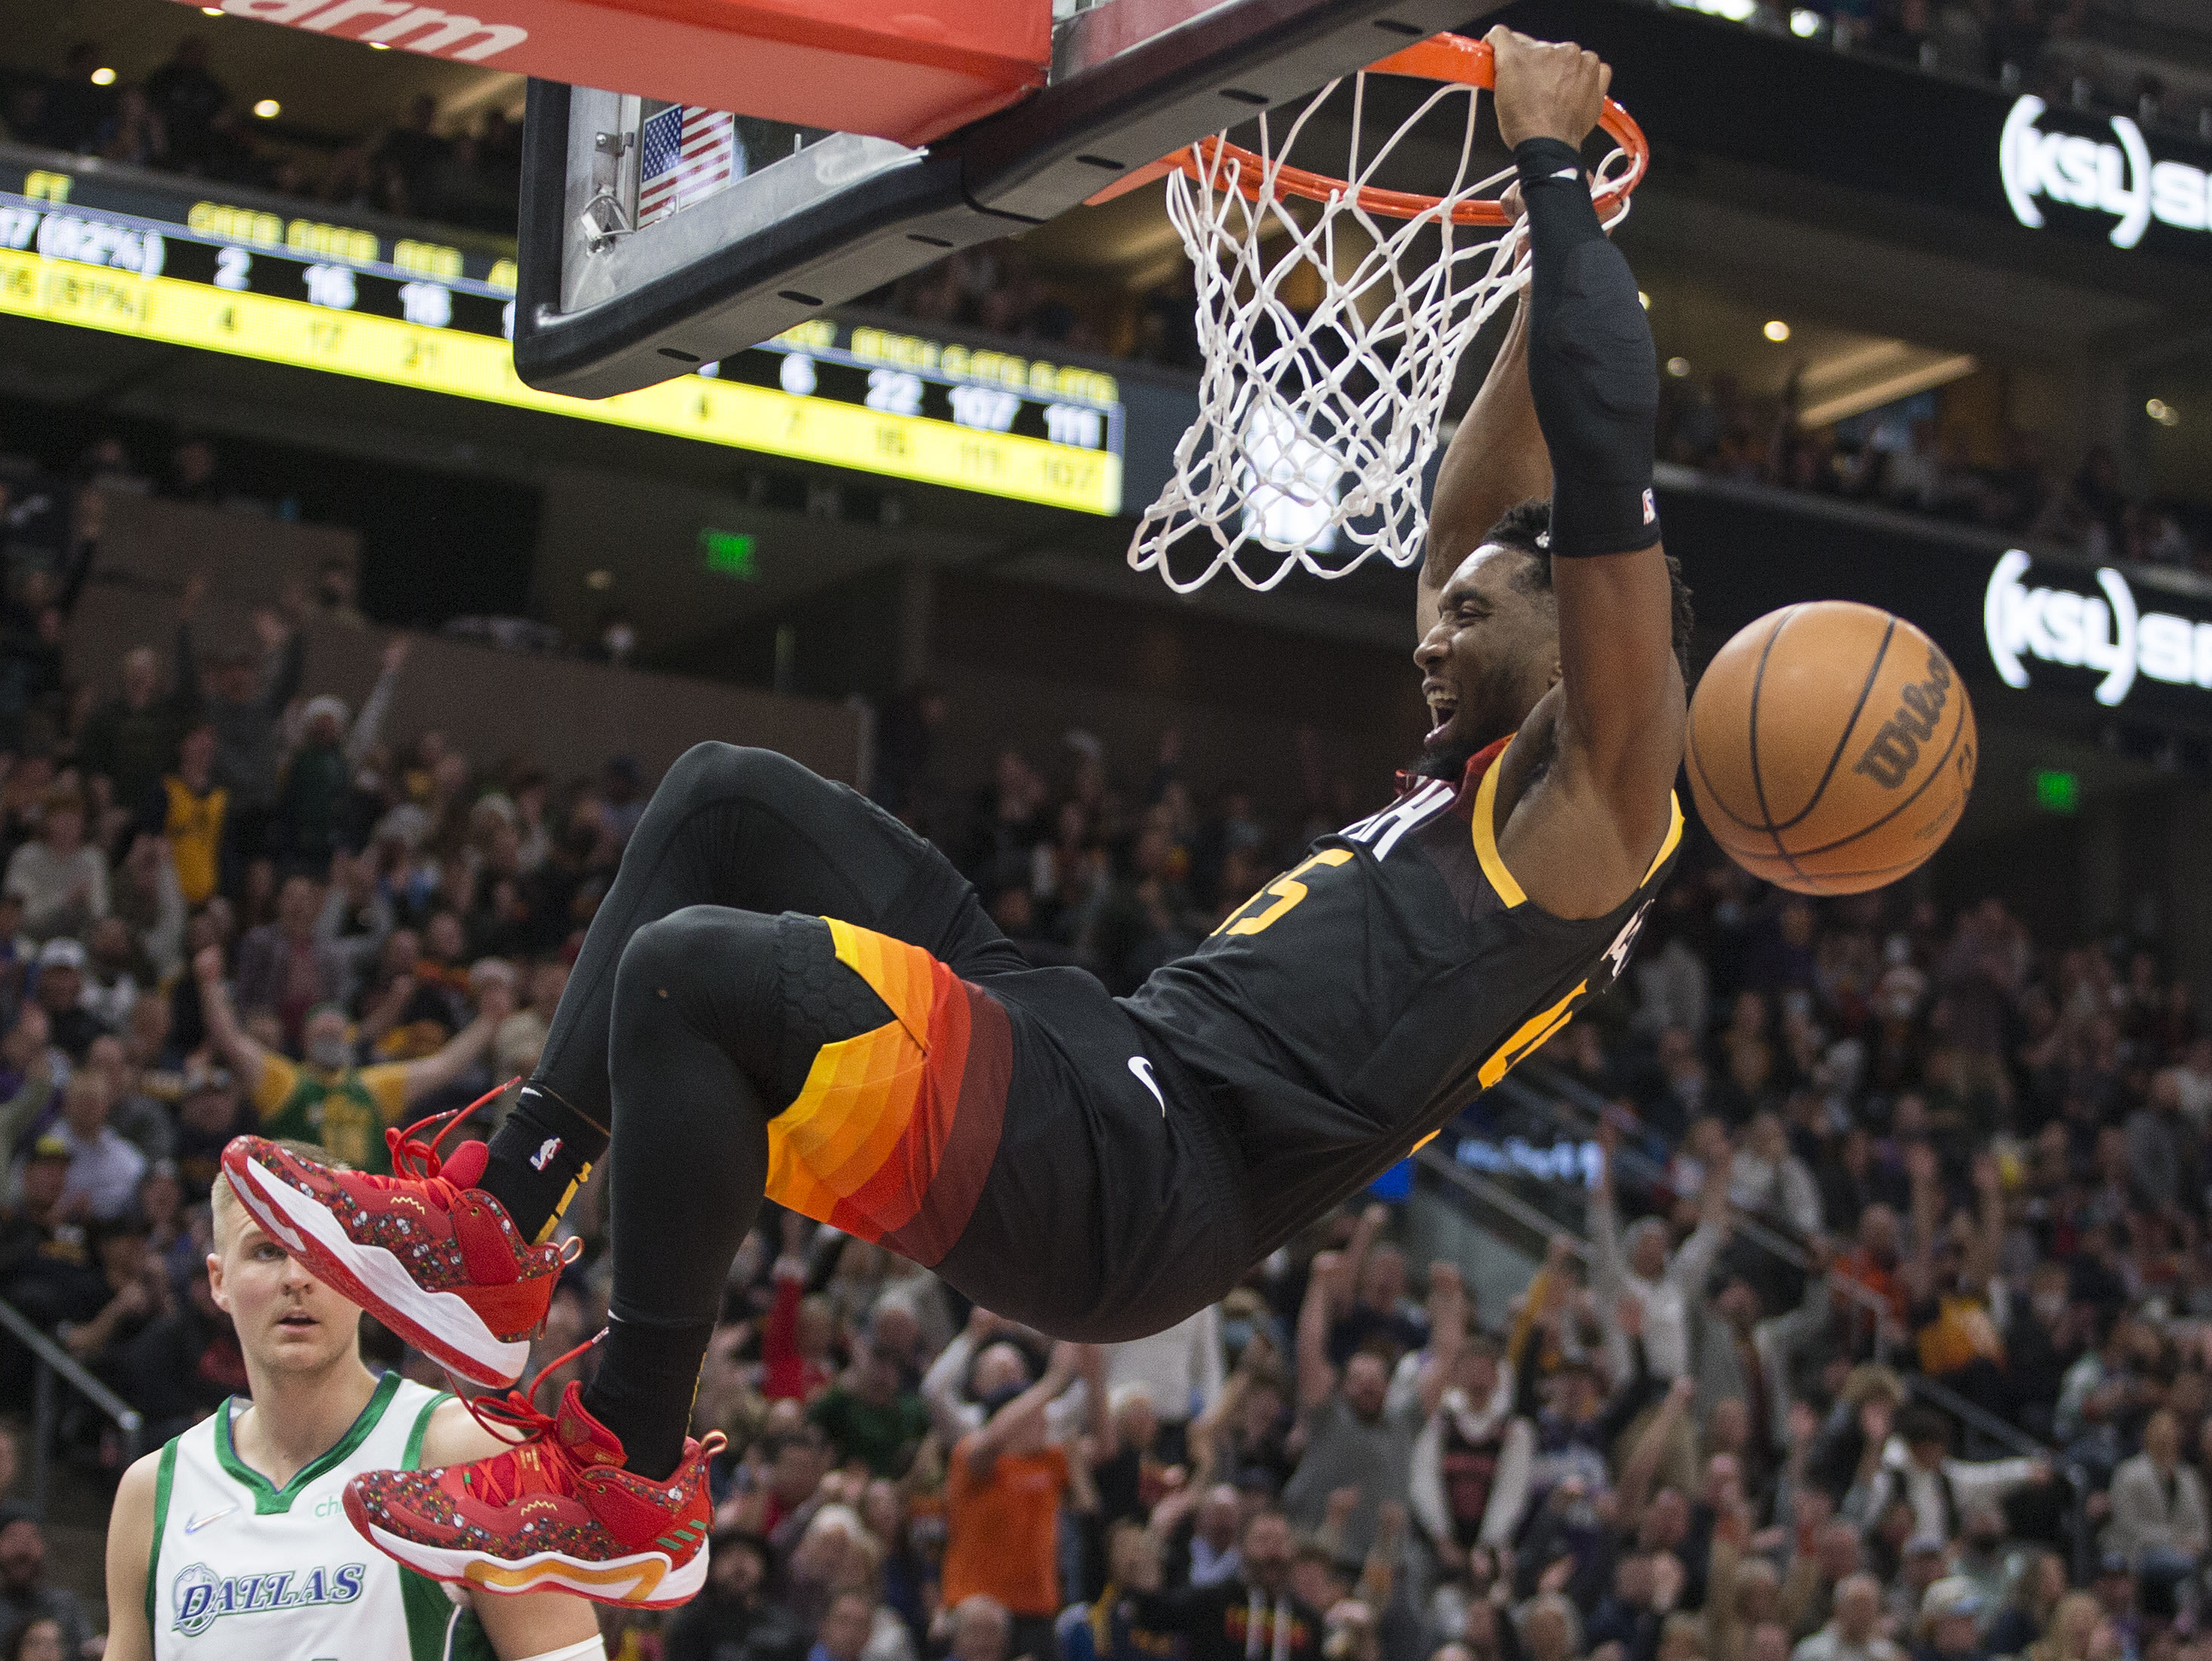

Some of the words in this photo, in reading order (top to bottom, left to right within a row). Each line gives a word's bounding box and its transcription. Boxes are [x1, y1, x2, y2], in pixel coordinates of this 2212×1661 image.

[2149, 161, 2212, 233] S
[214, 247, 252, 290] 2
[864, 367, 923, 416] 22
[948, 385, 1021, 432] 107
[1043, 404, 1100, 450] 111
[172, 1562, 367, 1635] DALLAS
